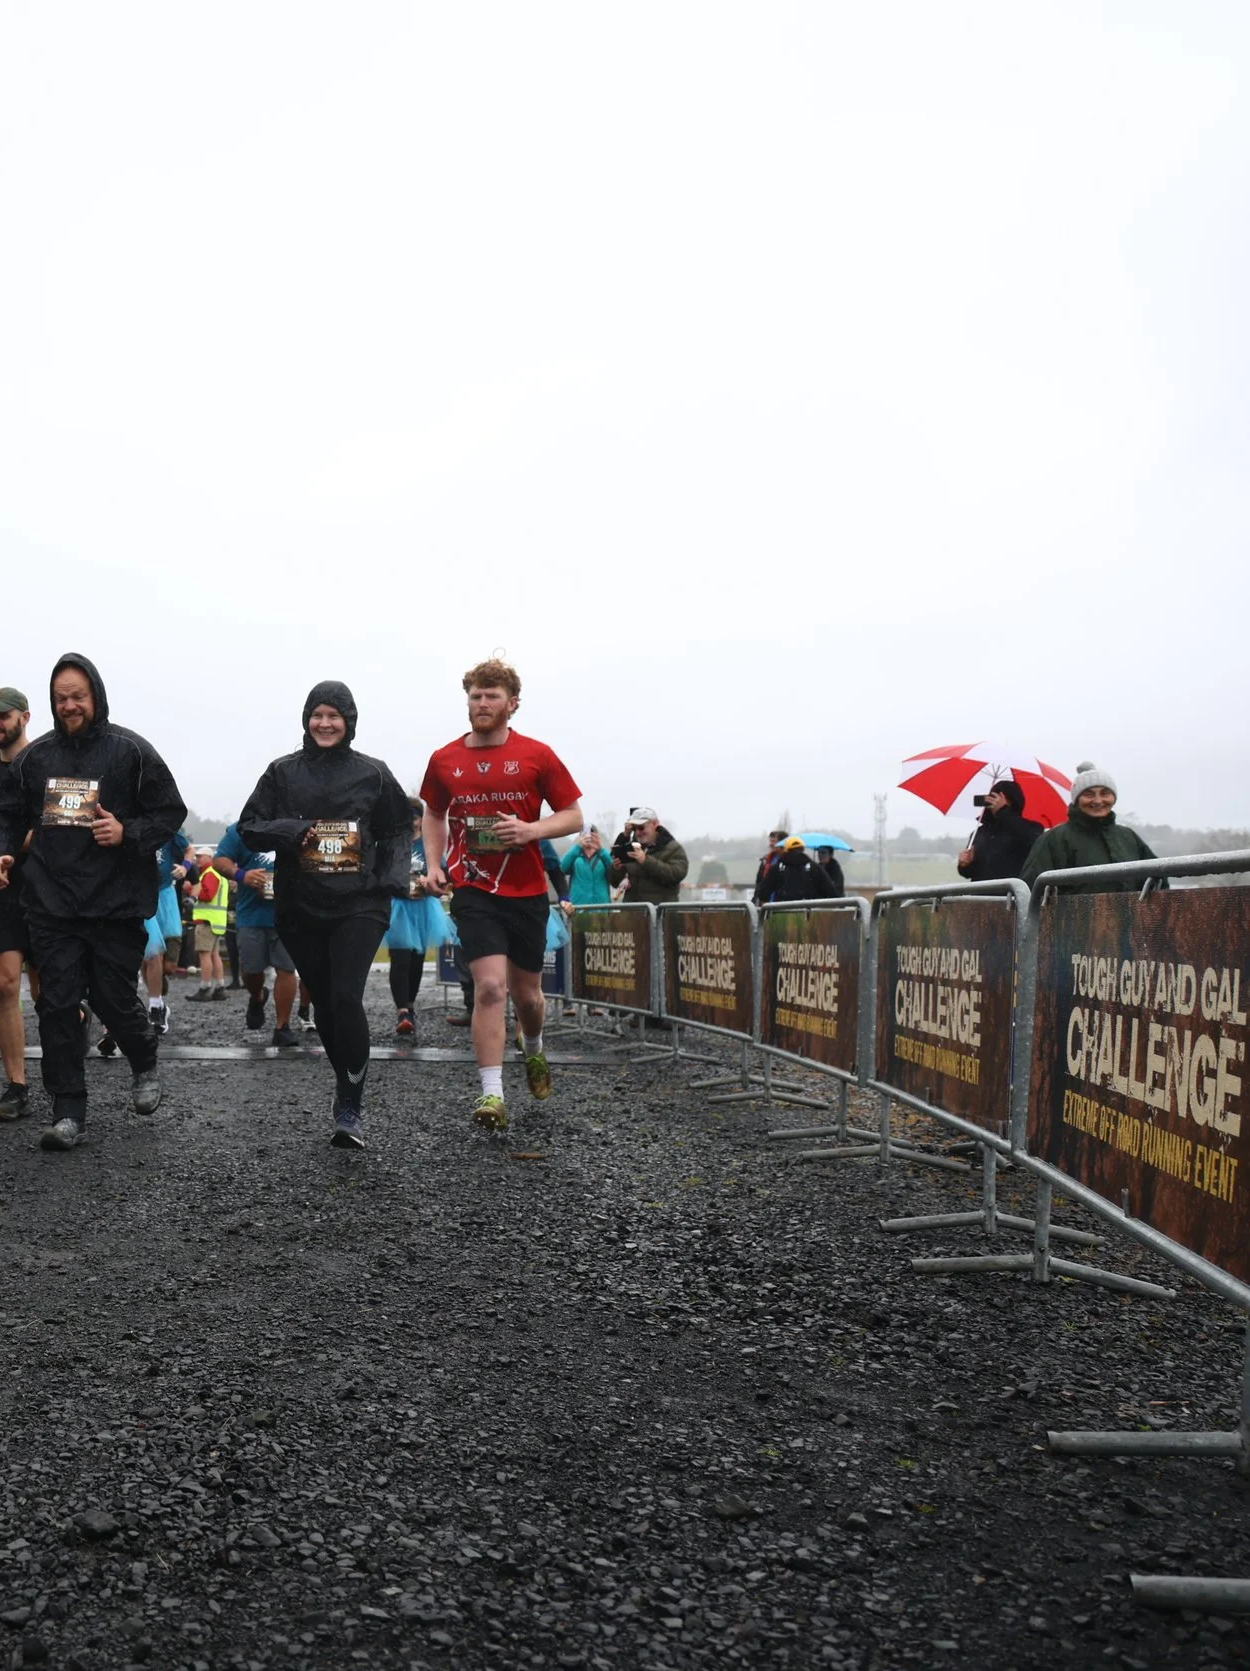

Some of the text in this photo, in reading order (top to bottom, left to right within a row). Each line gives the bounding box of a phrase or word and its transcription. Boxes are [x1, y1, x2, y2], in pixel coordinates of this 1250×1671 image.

[59, 794, 81, 809] 499
[491, 791, 528, 801] RUGBY
[317, 839, 342, 854] 498
[584, 947, 636, 974] CHALLENGE
[678, 954, 736, 990] CHALLENGE
[896, 945, 982, 982] TOUGH GUY AND GAL
[776, 967, 839, 1012] CHALLENGE
[1071, 953, 1247, 1026] TOUGH GUY AND GAL
[895, 979, 982, 1047] CHALLENGE
[1066, 1006, 1246, 1137] CHALLENGE
[1063, 1088, 1238, 1204] EXTREME OFF ROAD RUNNING EVENT
